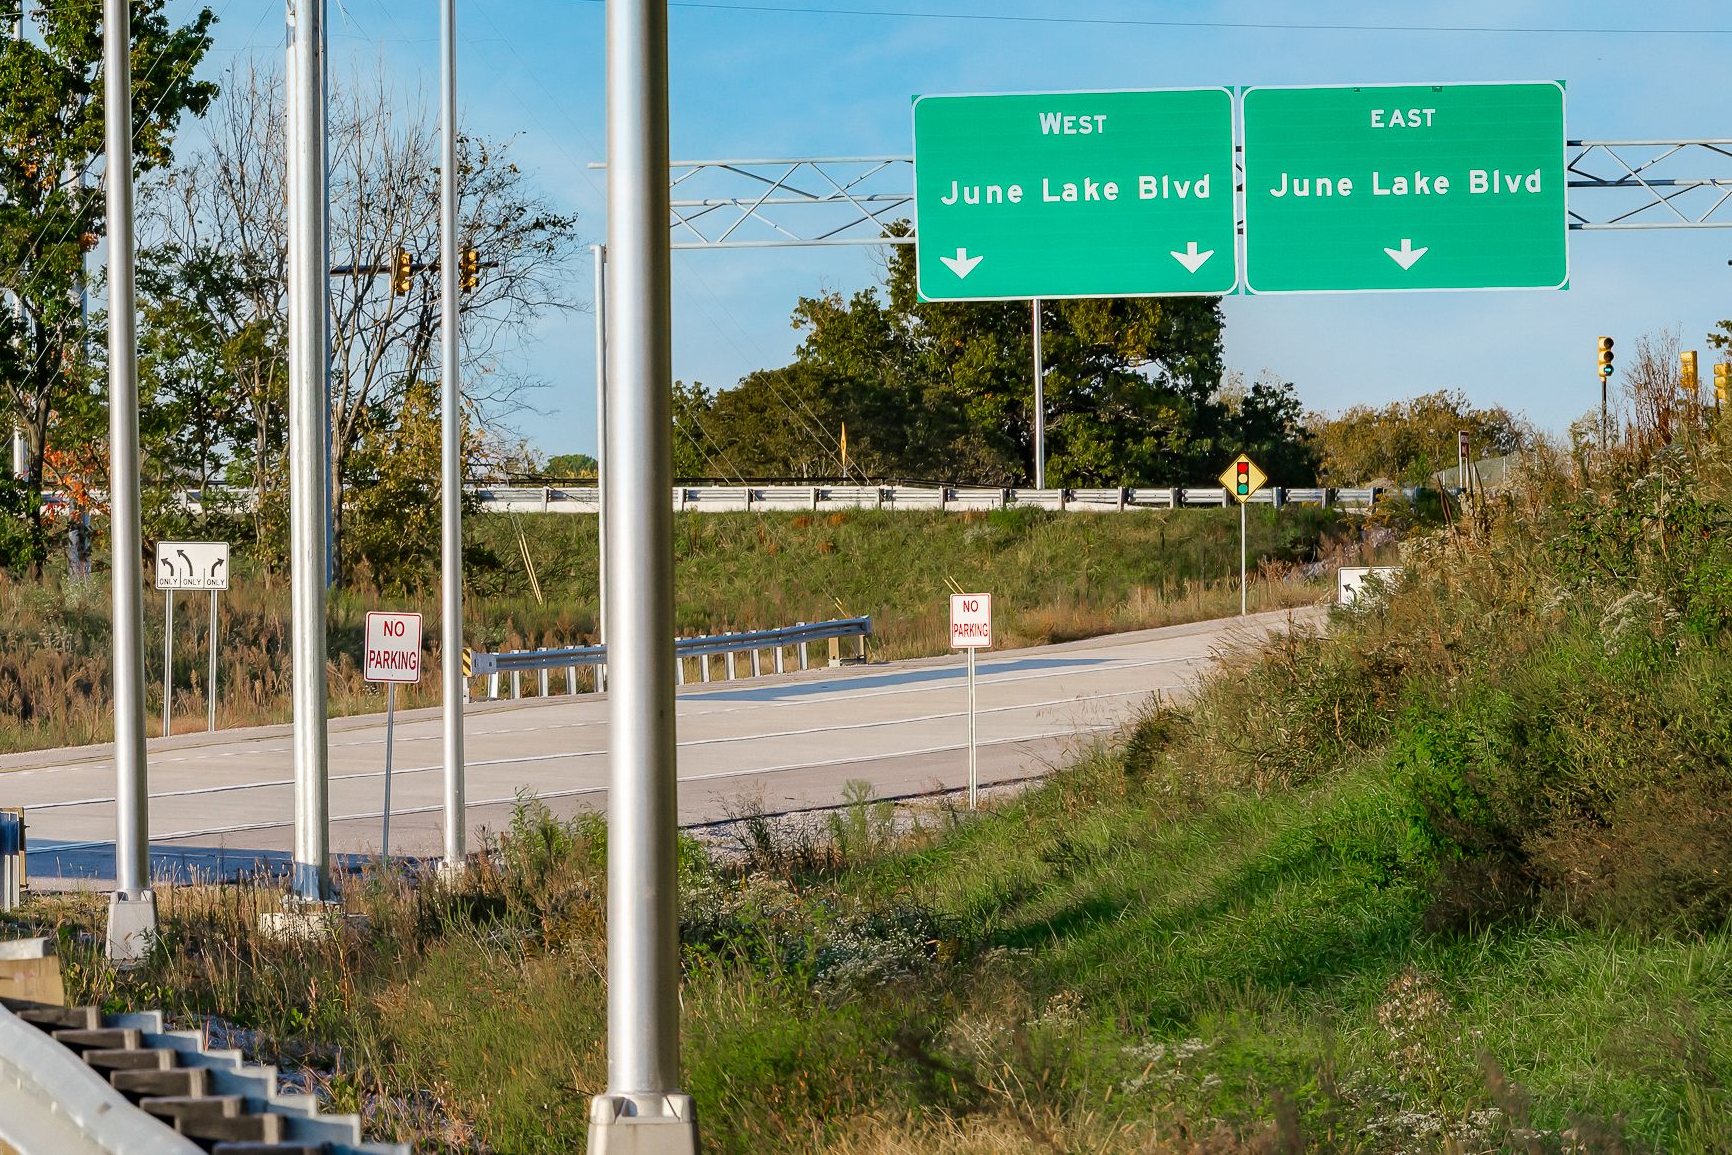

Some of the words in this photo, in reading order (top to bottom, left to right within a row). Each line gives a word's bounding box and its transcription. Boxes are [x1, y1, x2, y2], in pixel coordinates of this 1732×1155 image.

[1039, 112, 1107, 135] WEST
[1370, 108, 1436, 128] EAST
[940, 180, 1024, 206] June
[1042, 177, 1119, 202] Lake
[1138, 173, 1210, 200] Blvd
[1269, 173, 1353, 198] June
[1372, 170, 1450, 196] Lake
[1469, 168, 1541, 194] Blvd
[159, 578, 178, 586] ONLY
[183, 578, 202, 586] ONLY
[206, 578, 225, 586] ONLY
[963, 599, 979, 613] NO
[383, 620, 405, 637] NO
[953, 623, 988, 638] PARKING
[368, 649, 417, 670] PARKING
